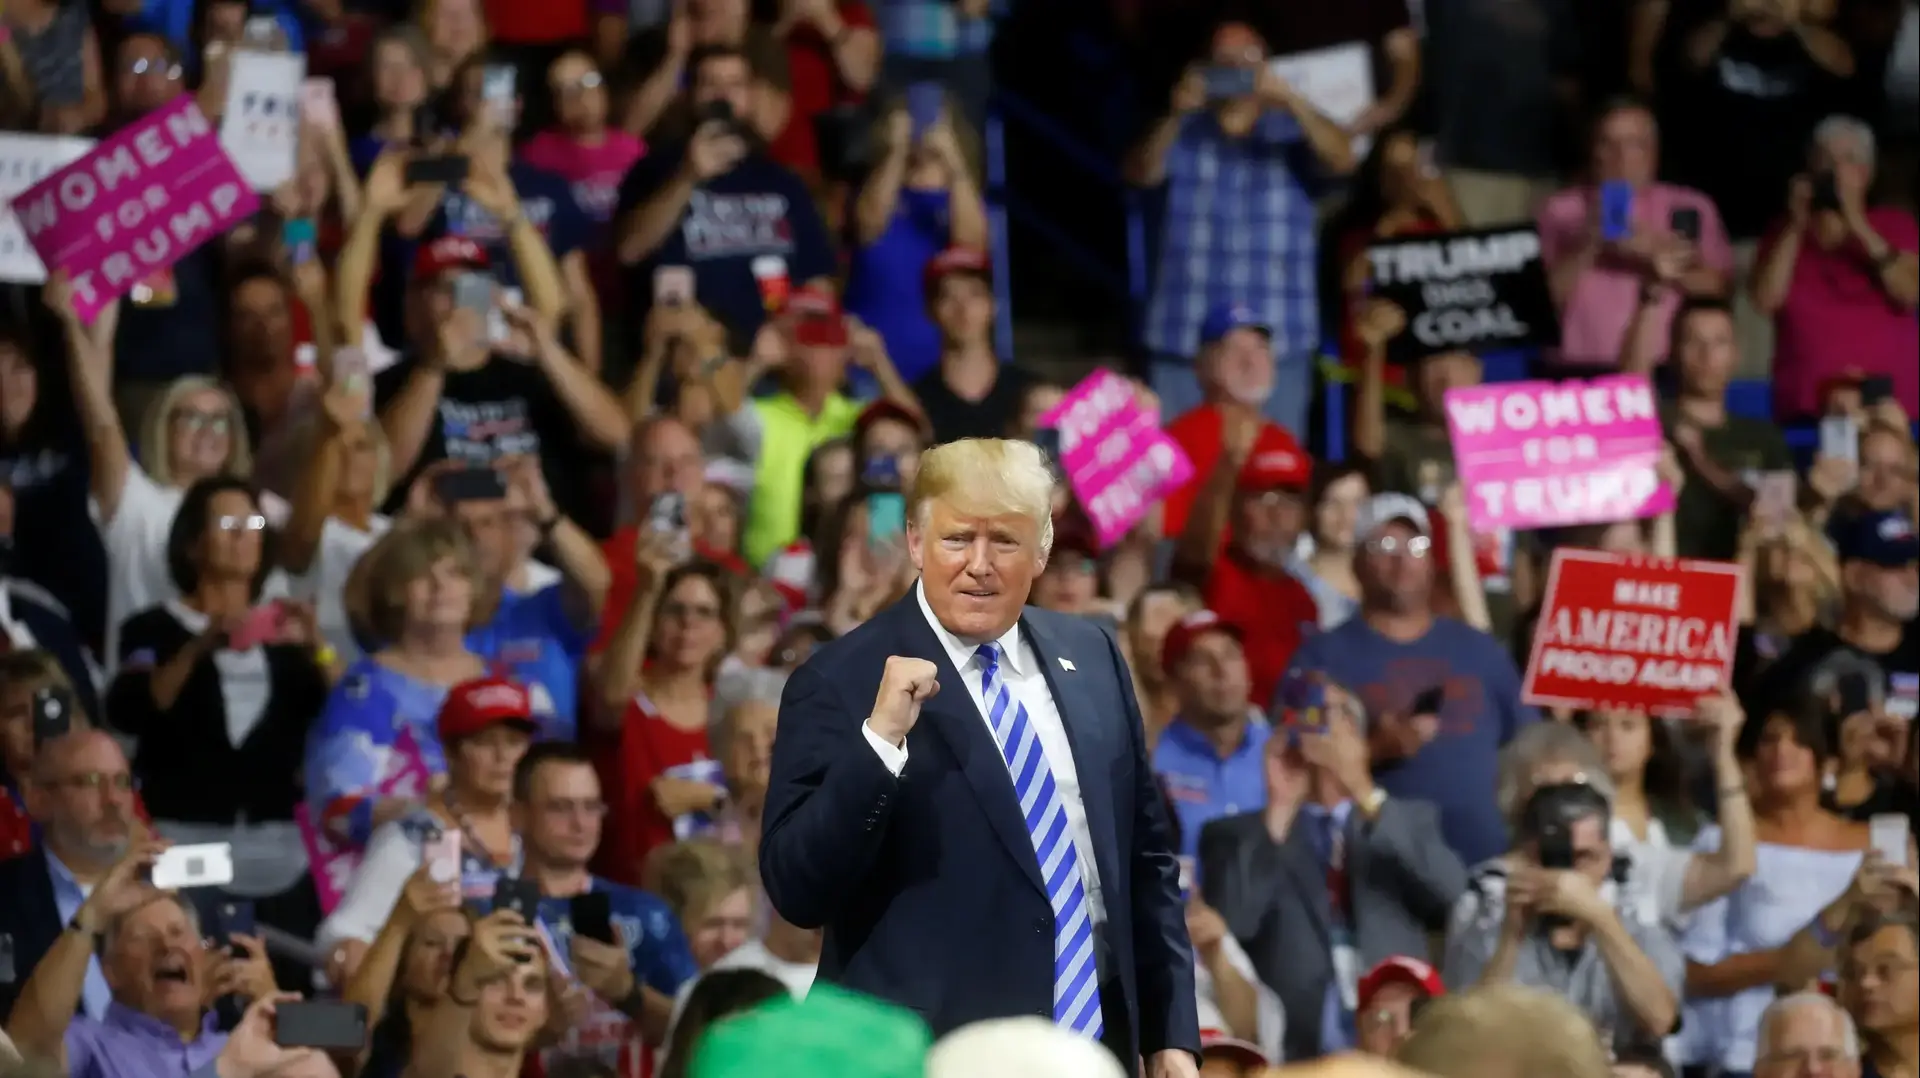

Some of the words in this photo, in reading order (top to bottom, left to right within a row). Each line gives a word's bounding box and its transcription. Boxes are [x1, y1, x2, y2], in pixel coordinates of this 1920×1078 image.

[17, 101, 209, 236] WOMEN
[97, 183, 170, 242] FOR
[73, 182, 240, 304] TRUMP
[1367, 232, 1541, 284] TRUMP
[1413, 304, 1530, 346] COAL
[1448, 386, 1654, 435] WOMEN
[1523, 434, 1597, 466] FOR
[1474, 468, 1657, 518] TRUMP
[1613, 577, 1682, 611] MAKE
[1546, 605, 1730, 662] AMERICA
[1541, 648, 1637, 685] PROUD
